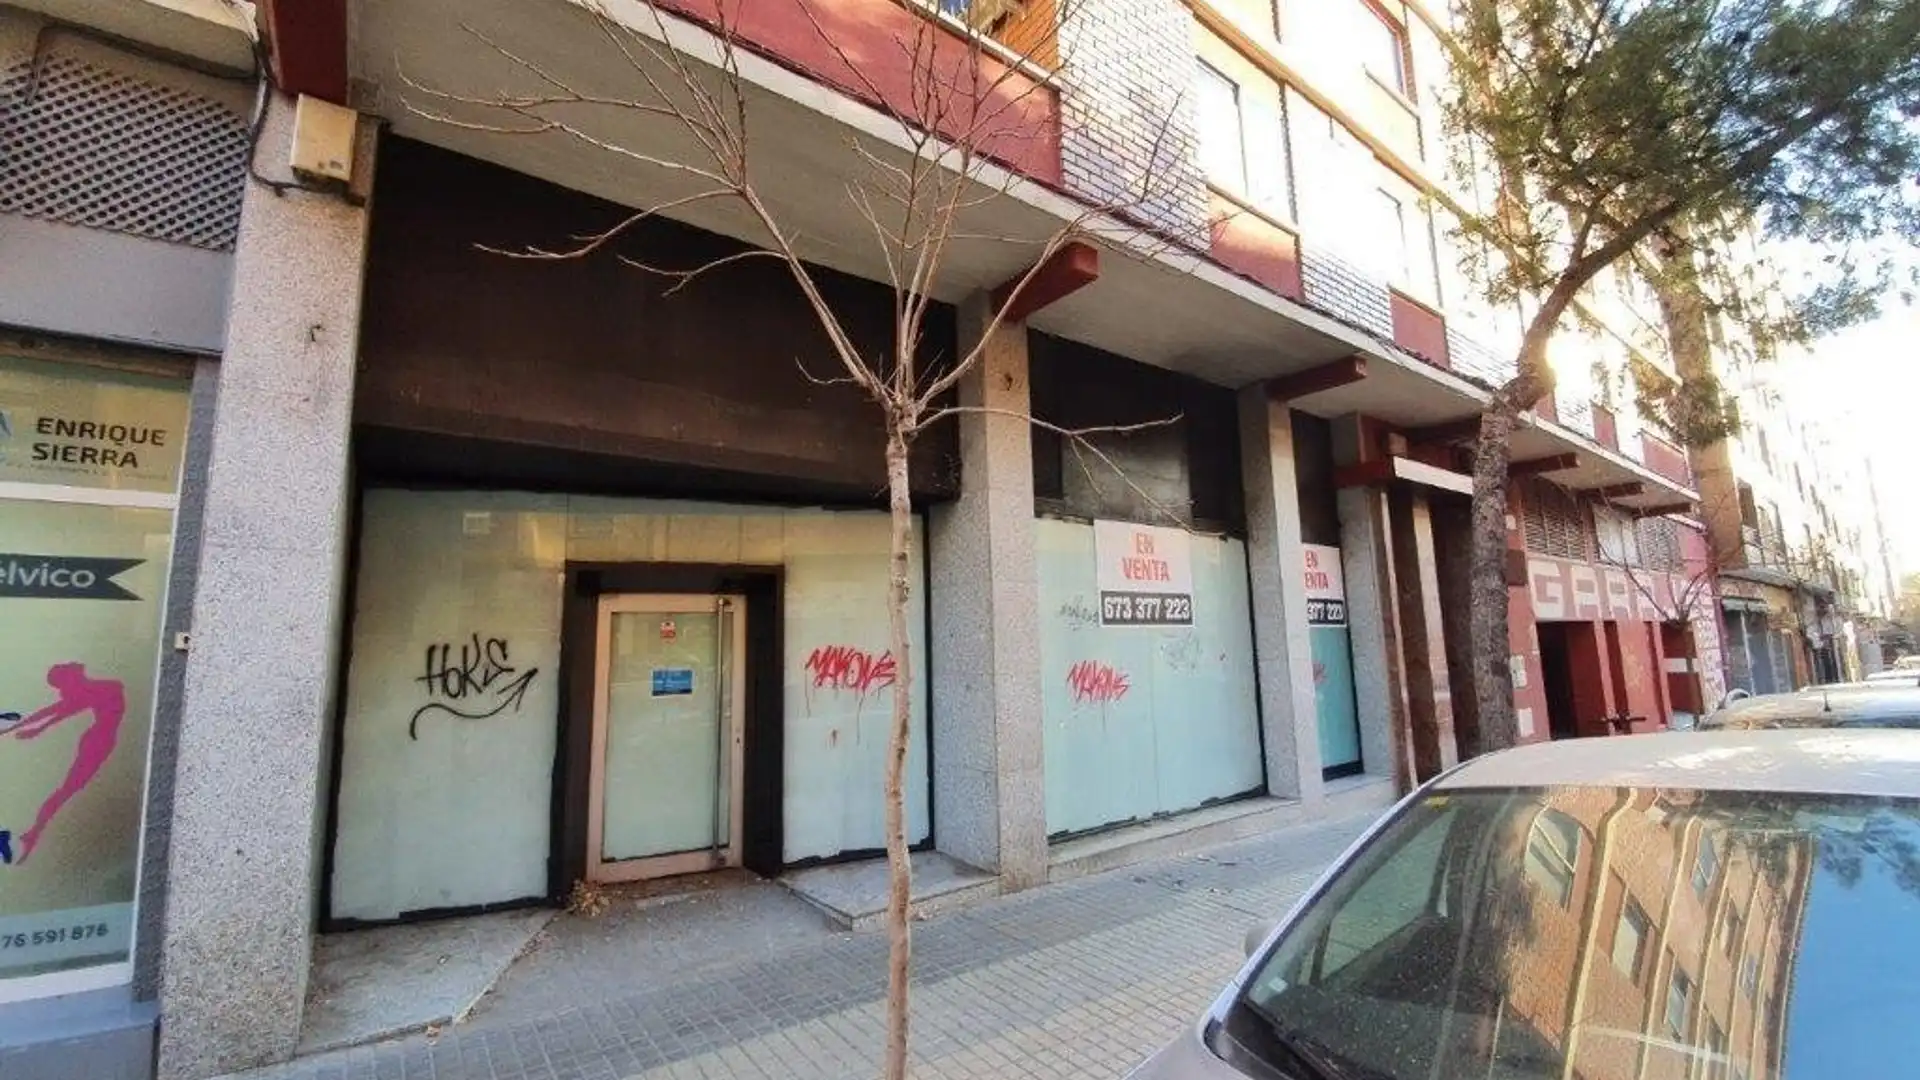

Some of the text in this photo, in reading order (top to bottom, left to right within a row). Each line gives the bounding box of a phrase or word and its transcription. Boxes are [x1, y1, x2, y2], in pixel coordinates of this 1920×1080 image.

[36, 417, 166, 446] ENRIQUE
[32, 442, 138, 468] SIERRA
[1135, 532, 1154, 554] EN
[1121, 557, 1170, 581] VENTA
[1305, 550, 1318, 568] EN
[1305, 572, 1329, 589] ENTA
[1104, 596, 1132, 619] 673
[1135, 598, 1161, 619] 377
[1165, 599, 1190, 619] 223
[2, 932, 26, 949] 76
[32, 927, 66, 946] 591
